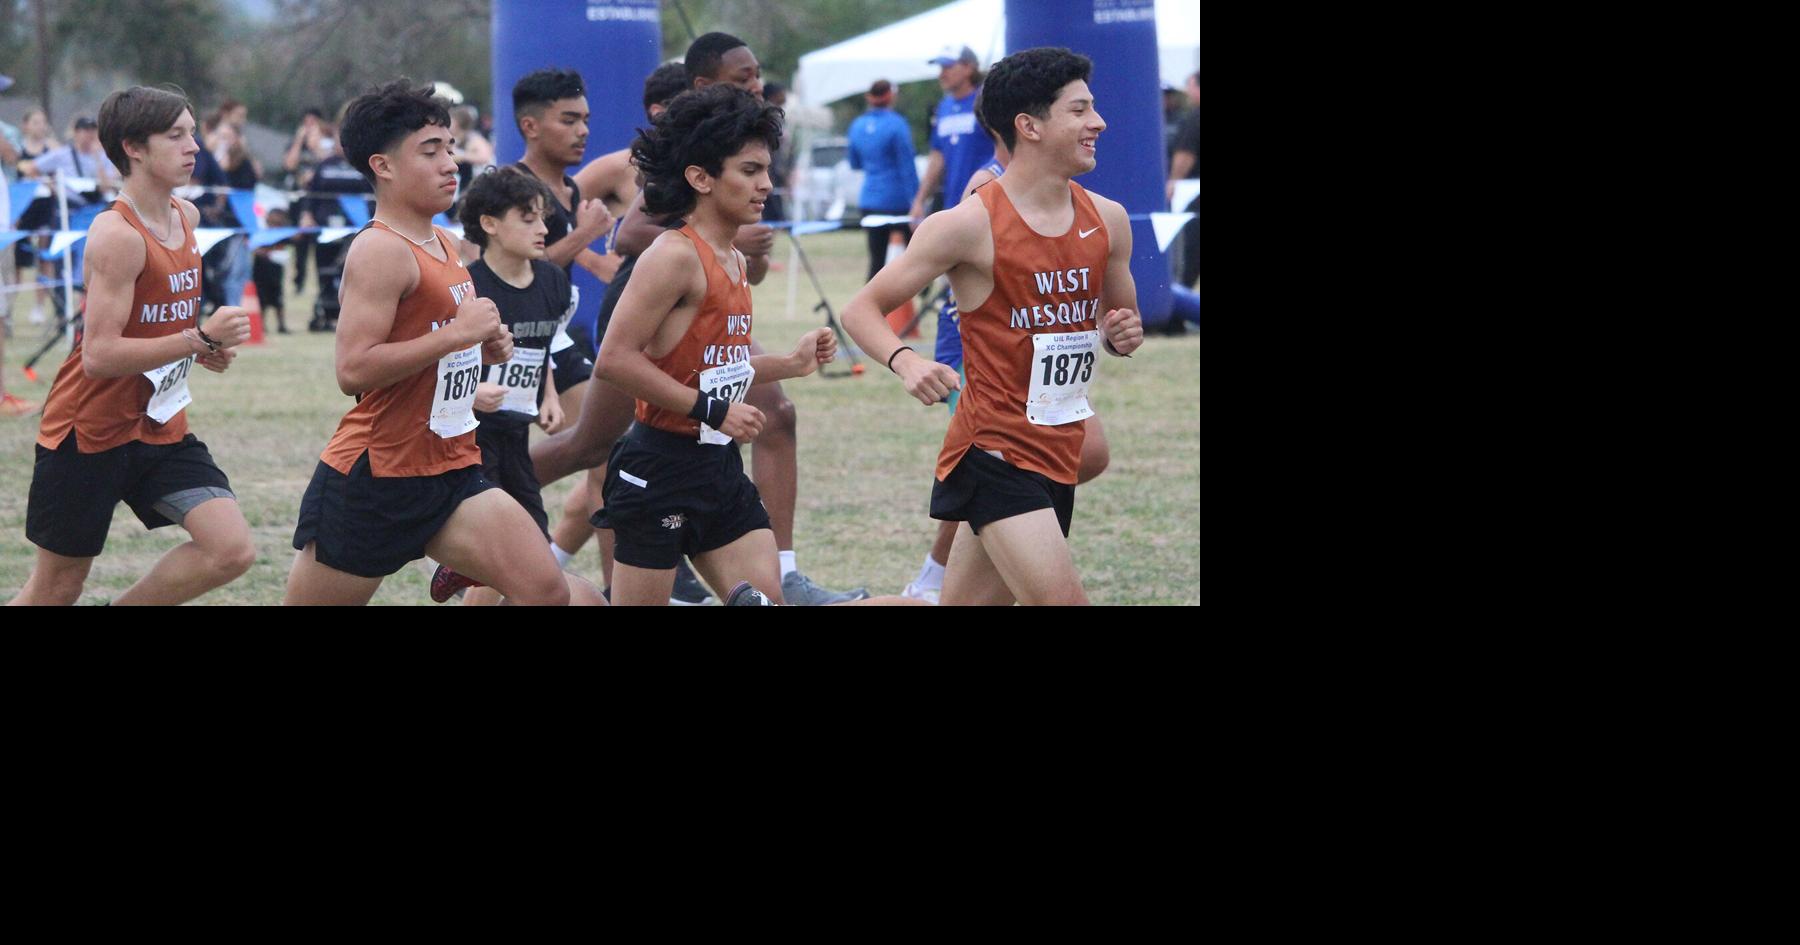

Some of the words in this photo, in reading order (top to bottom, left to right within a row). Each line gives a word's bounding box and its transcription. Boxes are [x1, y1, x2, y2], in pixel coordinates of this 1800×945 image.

[1034, 267, 1090, 295] WEST
[1065, 335, 1084, 343] Region
[443, 364, 480, 401] 1878
[1041, 351, 1095, 387] 1873
